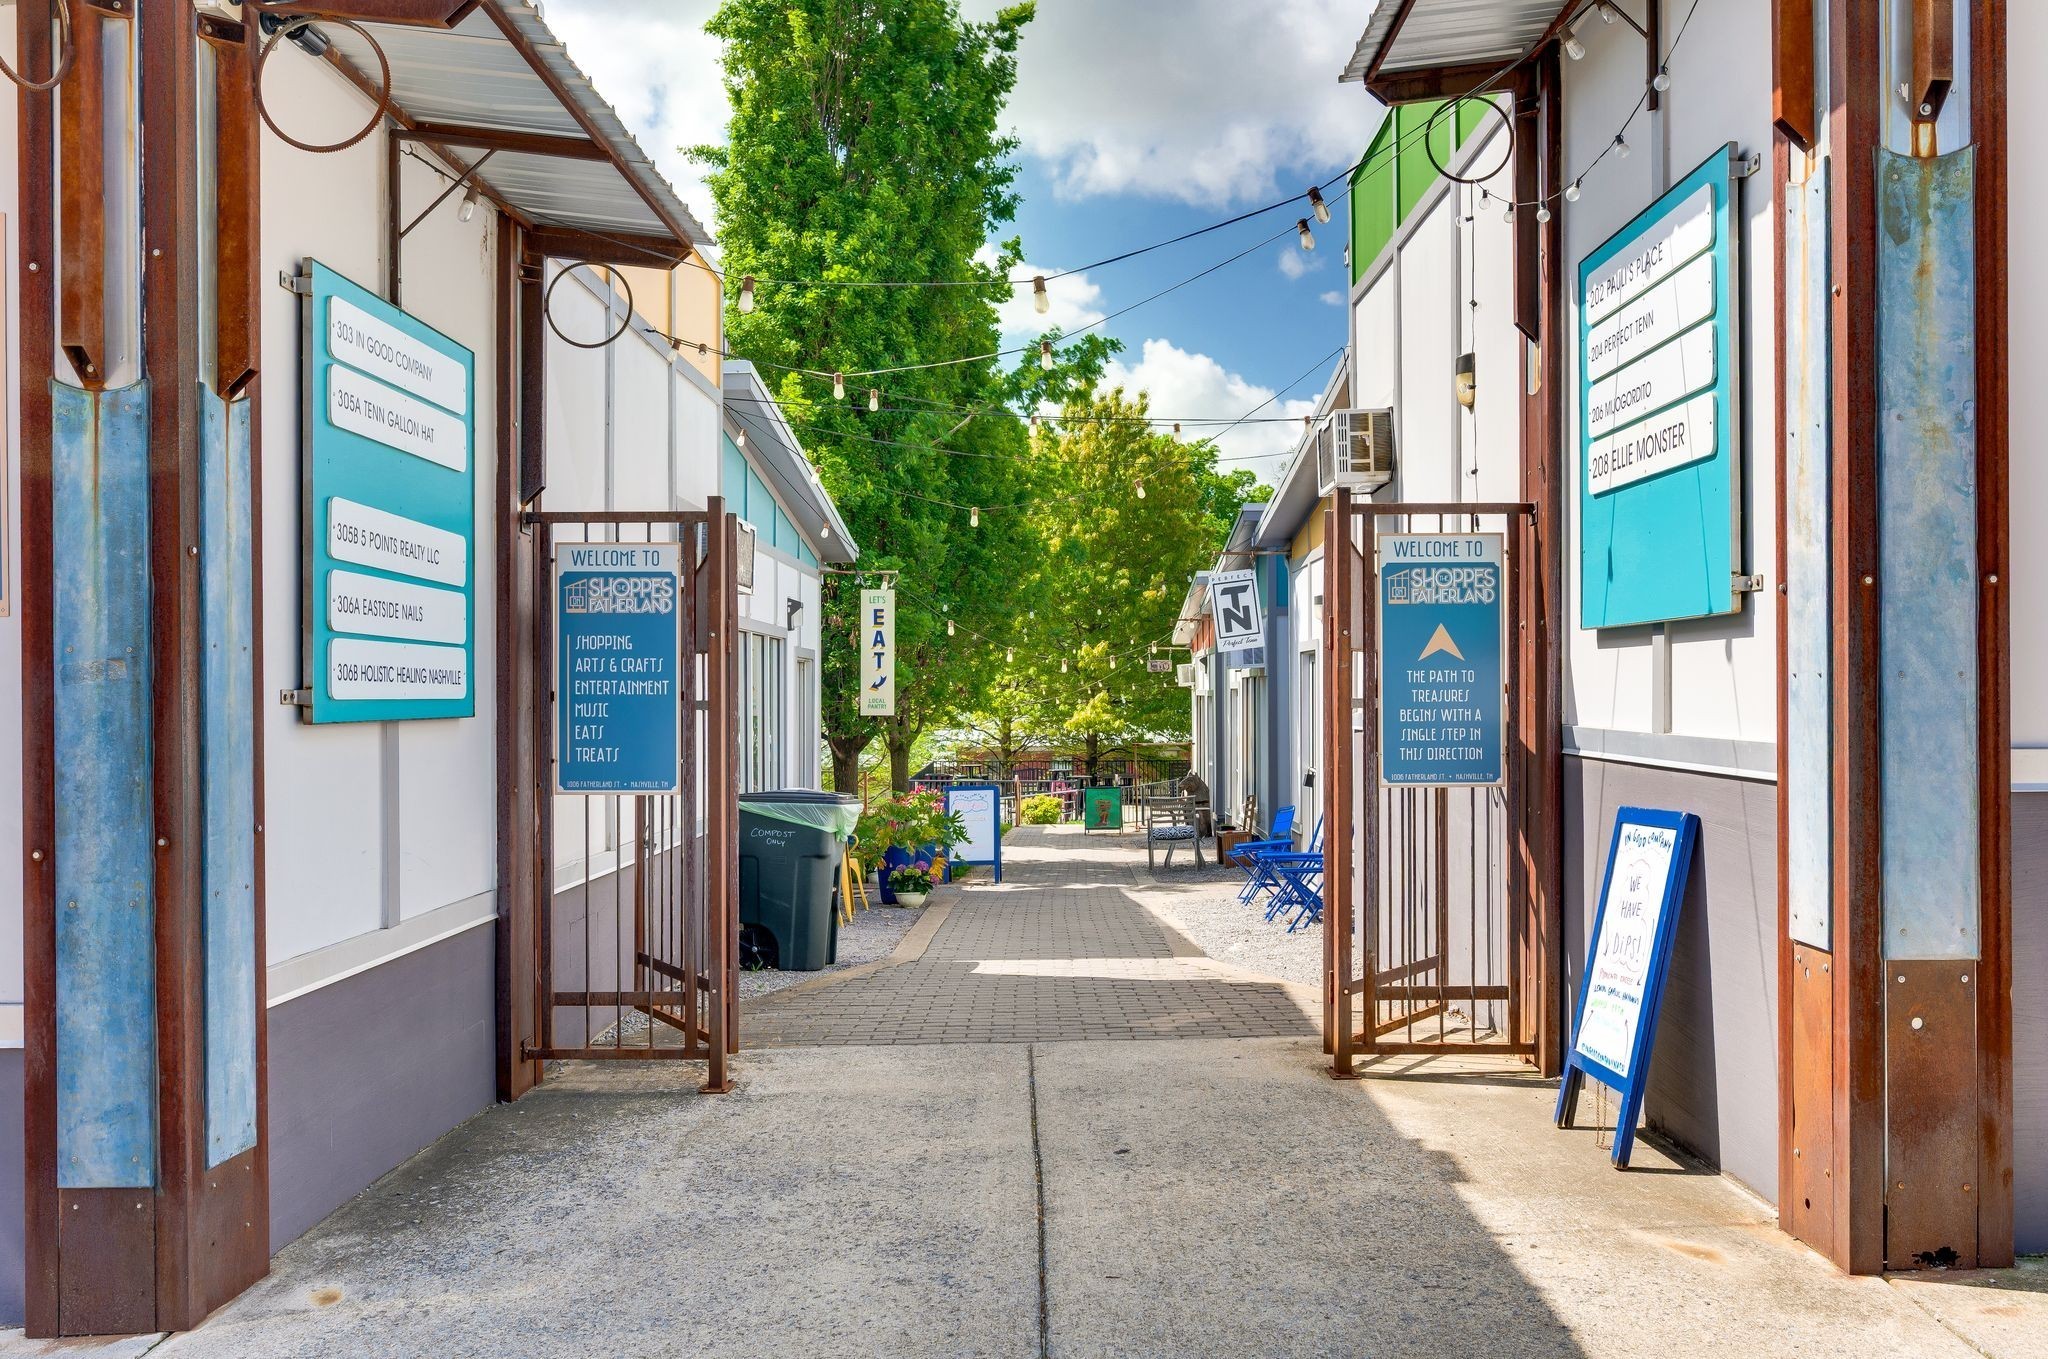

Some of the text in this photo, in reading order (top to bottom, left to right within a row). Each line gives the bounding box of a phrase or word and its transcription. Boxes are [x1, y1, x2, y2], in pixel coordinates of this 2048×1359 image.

[1589, 241, 1663, 309] 202 PAULI'S PLACE
[1591, 309, 1655, 363] 204 PERFECT TENN
[336, 320, 433, 383] 303 IN GOOD COMPANY
[337, 389, 434, 444] 305A TENN GALLON HAT
[1591, 404, 1603, 424] 206
[1592, 422, 1685, 480] 208 ELLIE MONSTER
[336, 522, 440, 565] 305B 5 POINTS REALTY LLC
[1393, 541, 1483, 558] WELCOME TO
[571, 549, 660, 567] WELCOME TO
[1212, 573, 1253, 582] PERFECT
[1410, 568, 1495, 588] SHOPPES
[588, 577, 673, 597] SHOPPES
[869, 596, 886, 604] LET'S
[1411, 587, 1494, 605] FATHERLAND
[337, 595, 423, 622] 306A EASTSIDE NAILS
[589, 596, 673, 615] FATHERLAND
[575, 635, 633, 650] SHOPPING
[872, 609, 885, 671] EAT
[575, 657, 663, 673] ARTS & CRAFTS
[337, 663, 461, 685] 306B HOLISTIC HEALING NASHVILLE
[1406, 669, 1475, 683] THE PATH TO
[575, 680, 669, 695] ENTERTAINMENT
[1412, 689, 1469, 702] TREASURES
[575, 703, 609, 718] MUSIC
[1399, 708, 1482, 722] BEGINS WITH A
[575, 725, 603, 740] EATS
[1401, 727, 1481, 741] SINGLE STEP IN
[575, 747, 619, 763] TREATS
[1399, 746, 1483, 761] THIS DIRECTION
[750, 828, 796, 837] COMPOST
[1633, 829, 1646, 847] GOOD
[766, 838, 786, 847] ONLY
[1630, 875, 1642, 892] WE
[1622, 900, 1642, 918] HAVE
